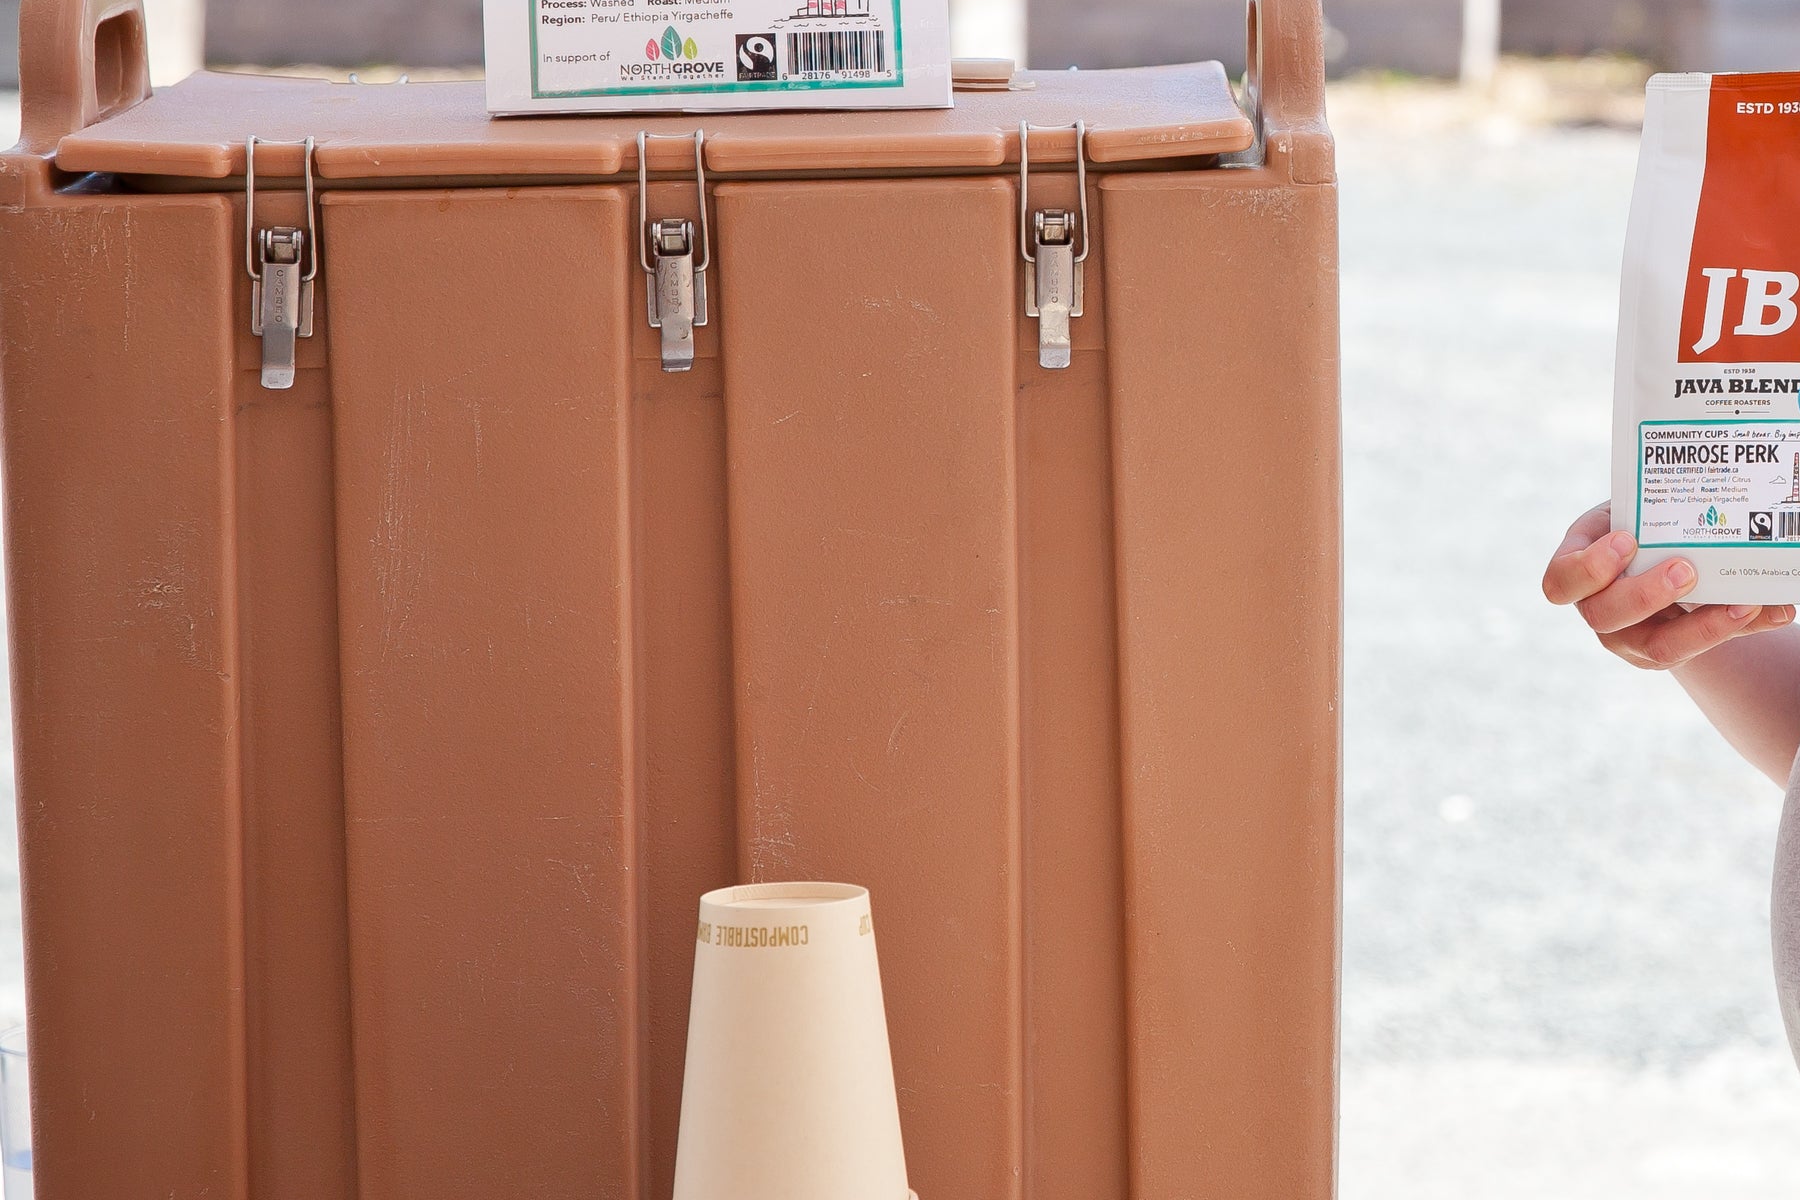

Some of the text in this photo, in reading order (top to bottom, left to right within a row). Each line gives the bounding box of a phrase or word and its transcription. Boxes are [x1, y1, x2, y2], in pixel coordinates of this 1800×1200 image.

[541, 0, 587, 9] Process:
[542, 9, 734, 26] Region: Peru/ Ethiopia Yirgacheffe
[543, 51, 611, 64] In support of
[620, 62, 724, 75] NORTHGROVE
[782, 69, 893, 81] 6 28176 91498 5
[1737, 102, 1774, 114] ESTD
[1691, 267, 1800, 355] JB
[1674, 378, 1724, 398] JAVA
[1644, 430, 1703, 440] COMMUNITY
[1704, 430, 1729, 439] CUPS
[1774, 429, 1786, 441] Big
[1644, 444, 1780, 465] PRIMROSE PERK
[1707, 466, 1739, 474] fairtrade.ca
[1683, 528, 1742, 536] NORTHGROVE
[1719, 568, 1737, 576] Café
[1739, 568, 1760, 576] 100%
[1761, 568, 1790, 576] Arabica
[716, 925, 809, 947] COMPOSTABLE
